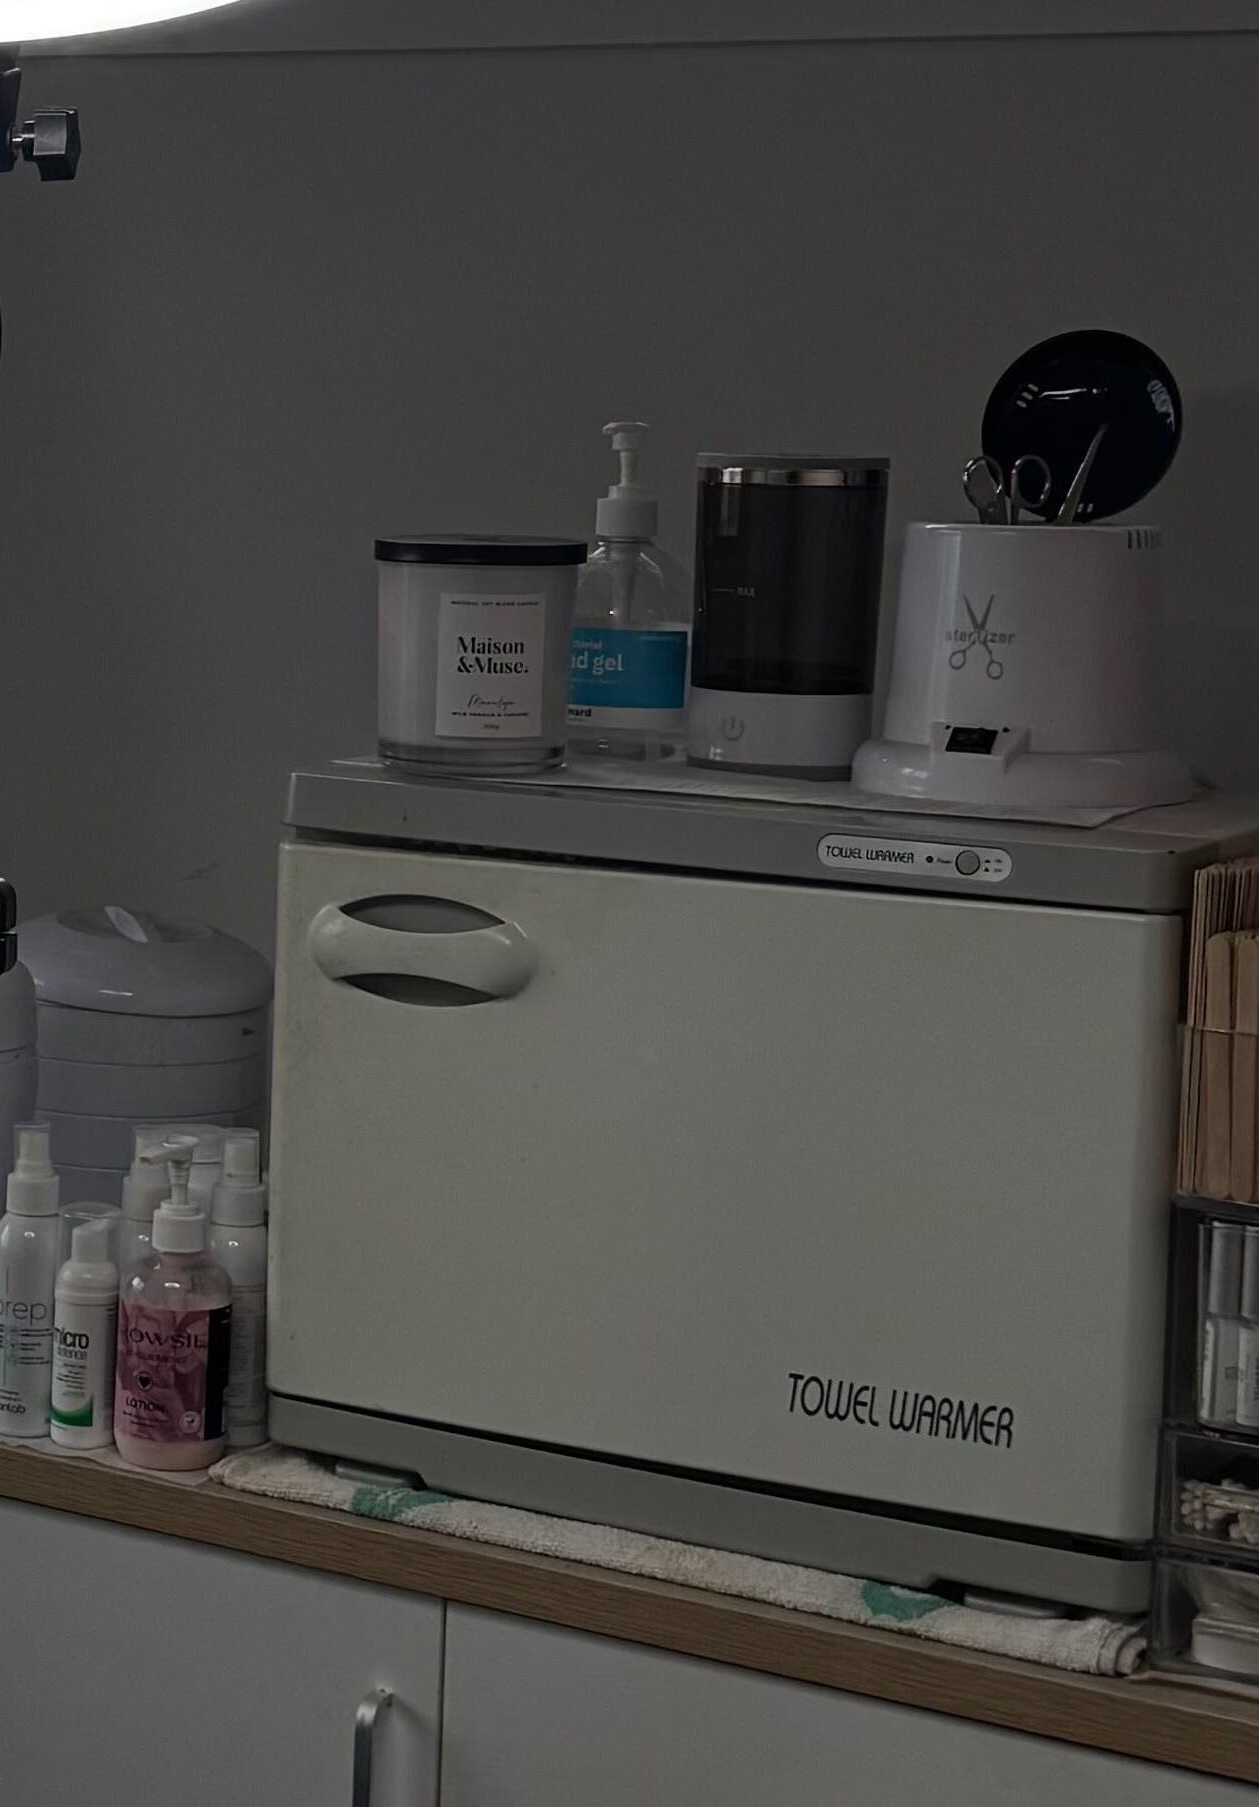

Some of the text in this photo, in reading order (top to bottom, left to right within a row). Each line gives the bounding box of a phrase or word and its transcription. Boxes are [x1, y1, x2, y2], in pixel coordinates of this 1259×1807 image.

[457, 635, 525, 655] Maison
[457, 655, 530, 675] &Muse.
[592, 653, 624, 676] gel
[825, 844, 915, 864] TOWEL WARMER
[788, 1372, 1014, 1449] TOWEL WARMER
